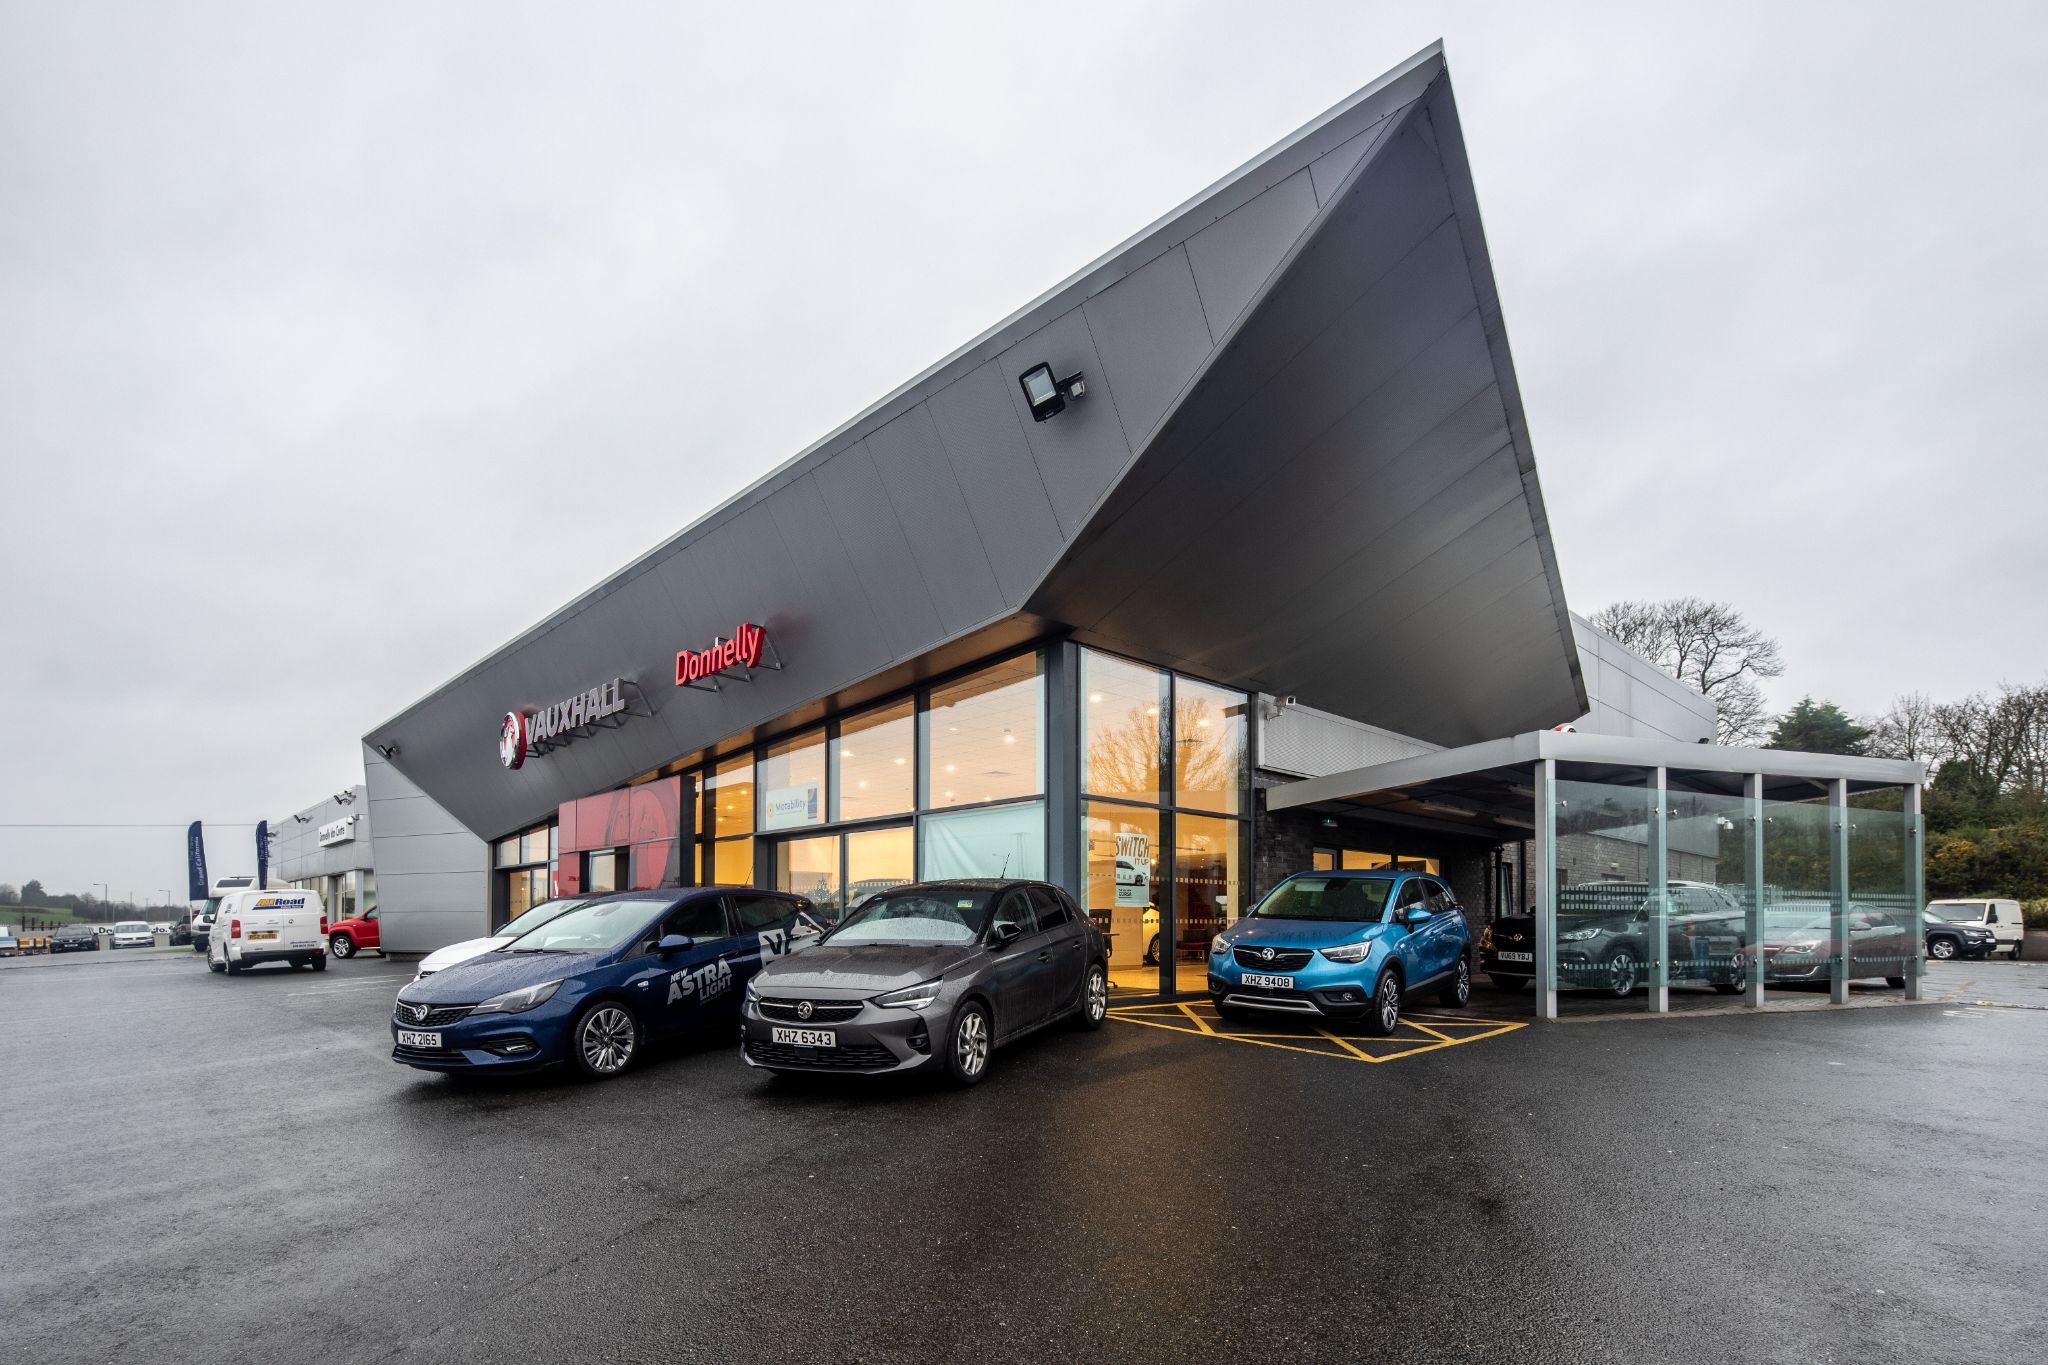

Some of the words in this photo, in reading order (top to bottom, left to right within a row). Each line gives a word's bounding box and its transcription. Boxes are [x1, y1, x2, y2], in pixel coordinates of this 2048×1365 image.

[675, 624, 765, 686] Donnelly
[524, 678, 625, 745] VAUXHALL
[775, 799, 805, 810] Motability
[194, 836, 203, 867] California
[1115, 836, 1149, 857] SWITCH
[667, 958, 732, 1005] ASTRA
[670, 967, 688, 984] NEW
[1244, 974, 1262, 986] XHZ
[1264, 976, 1290, 988] 9408
[699, 974, 733, 1001] LIGHT
[401, 1032, 416, 1045] XHZ
[417, 1033, 437, 1046] 2165
[776, 1029, 799, 1043] XHZ
[801, 1031, 832, 1046] 6343
